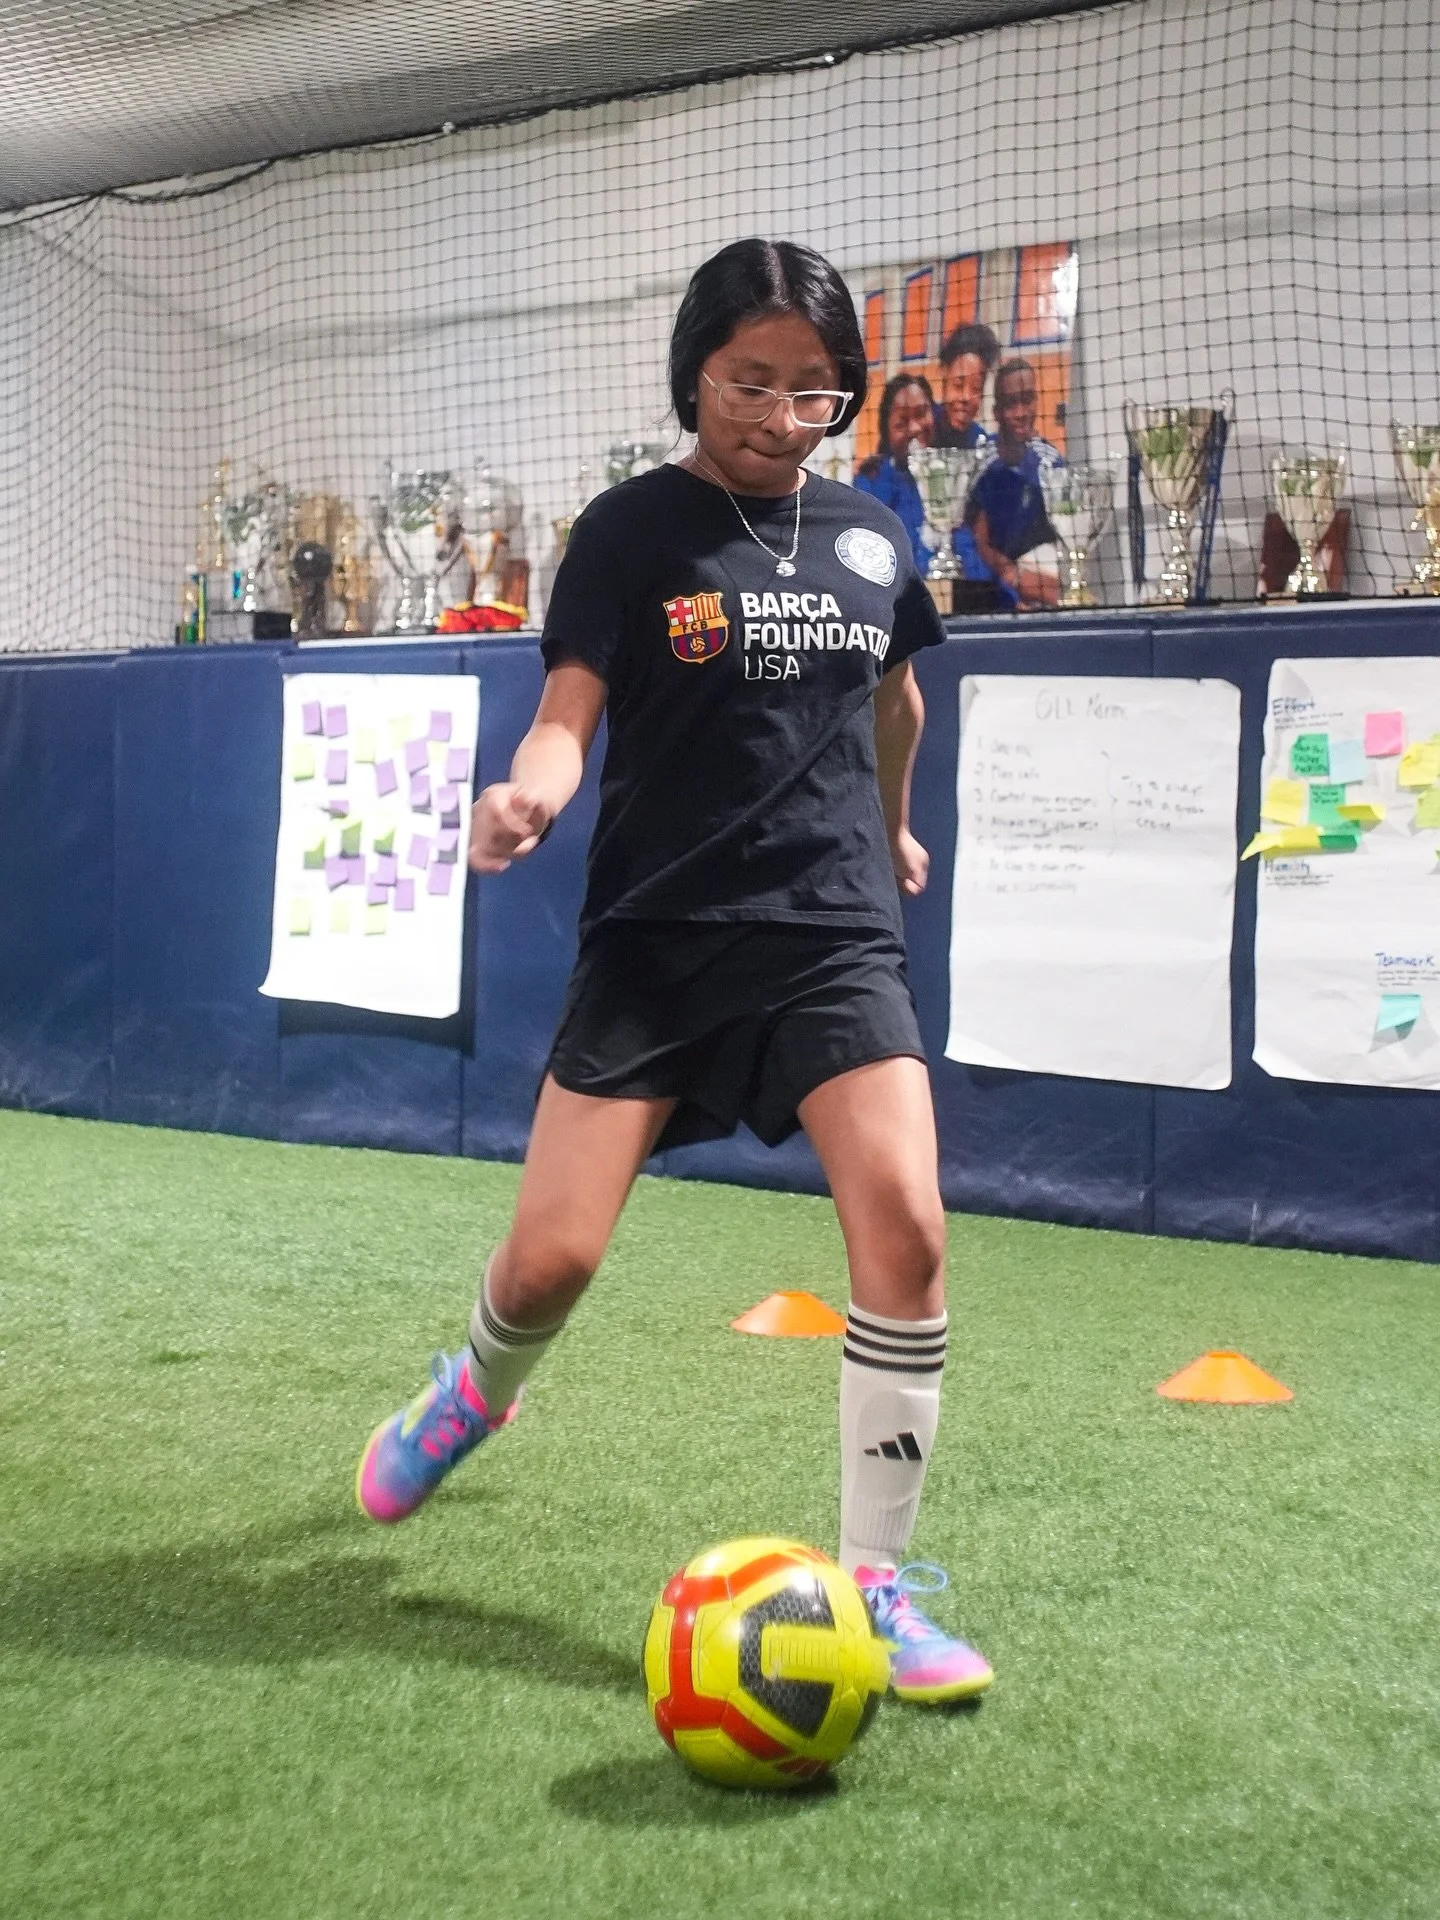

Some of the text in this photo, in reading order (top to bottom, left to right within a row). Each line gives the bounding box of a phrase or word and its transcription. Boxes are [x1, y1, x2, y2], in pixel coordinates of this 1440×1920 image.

[740, 592, 842, 623] BARÇA
[682, 621, 708, 634] FCB
[743, 623, 890, 661] FOUNDATIO
[744, 654, 801, 681] USA
